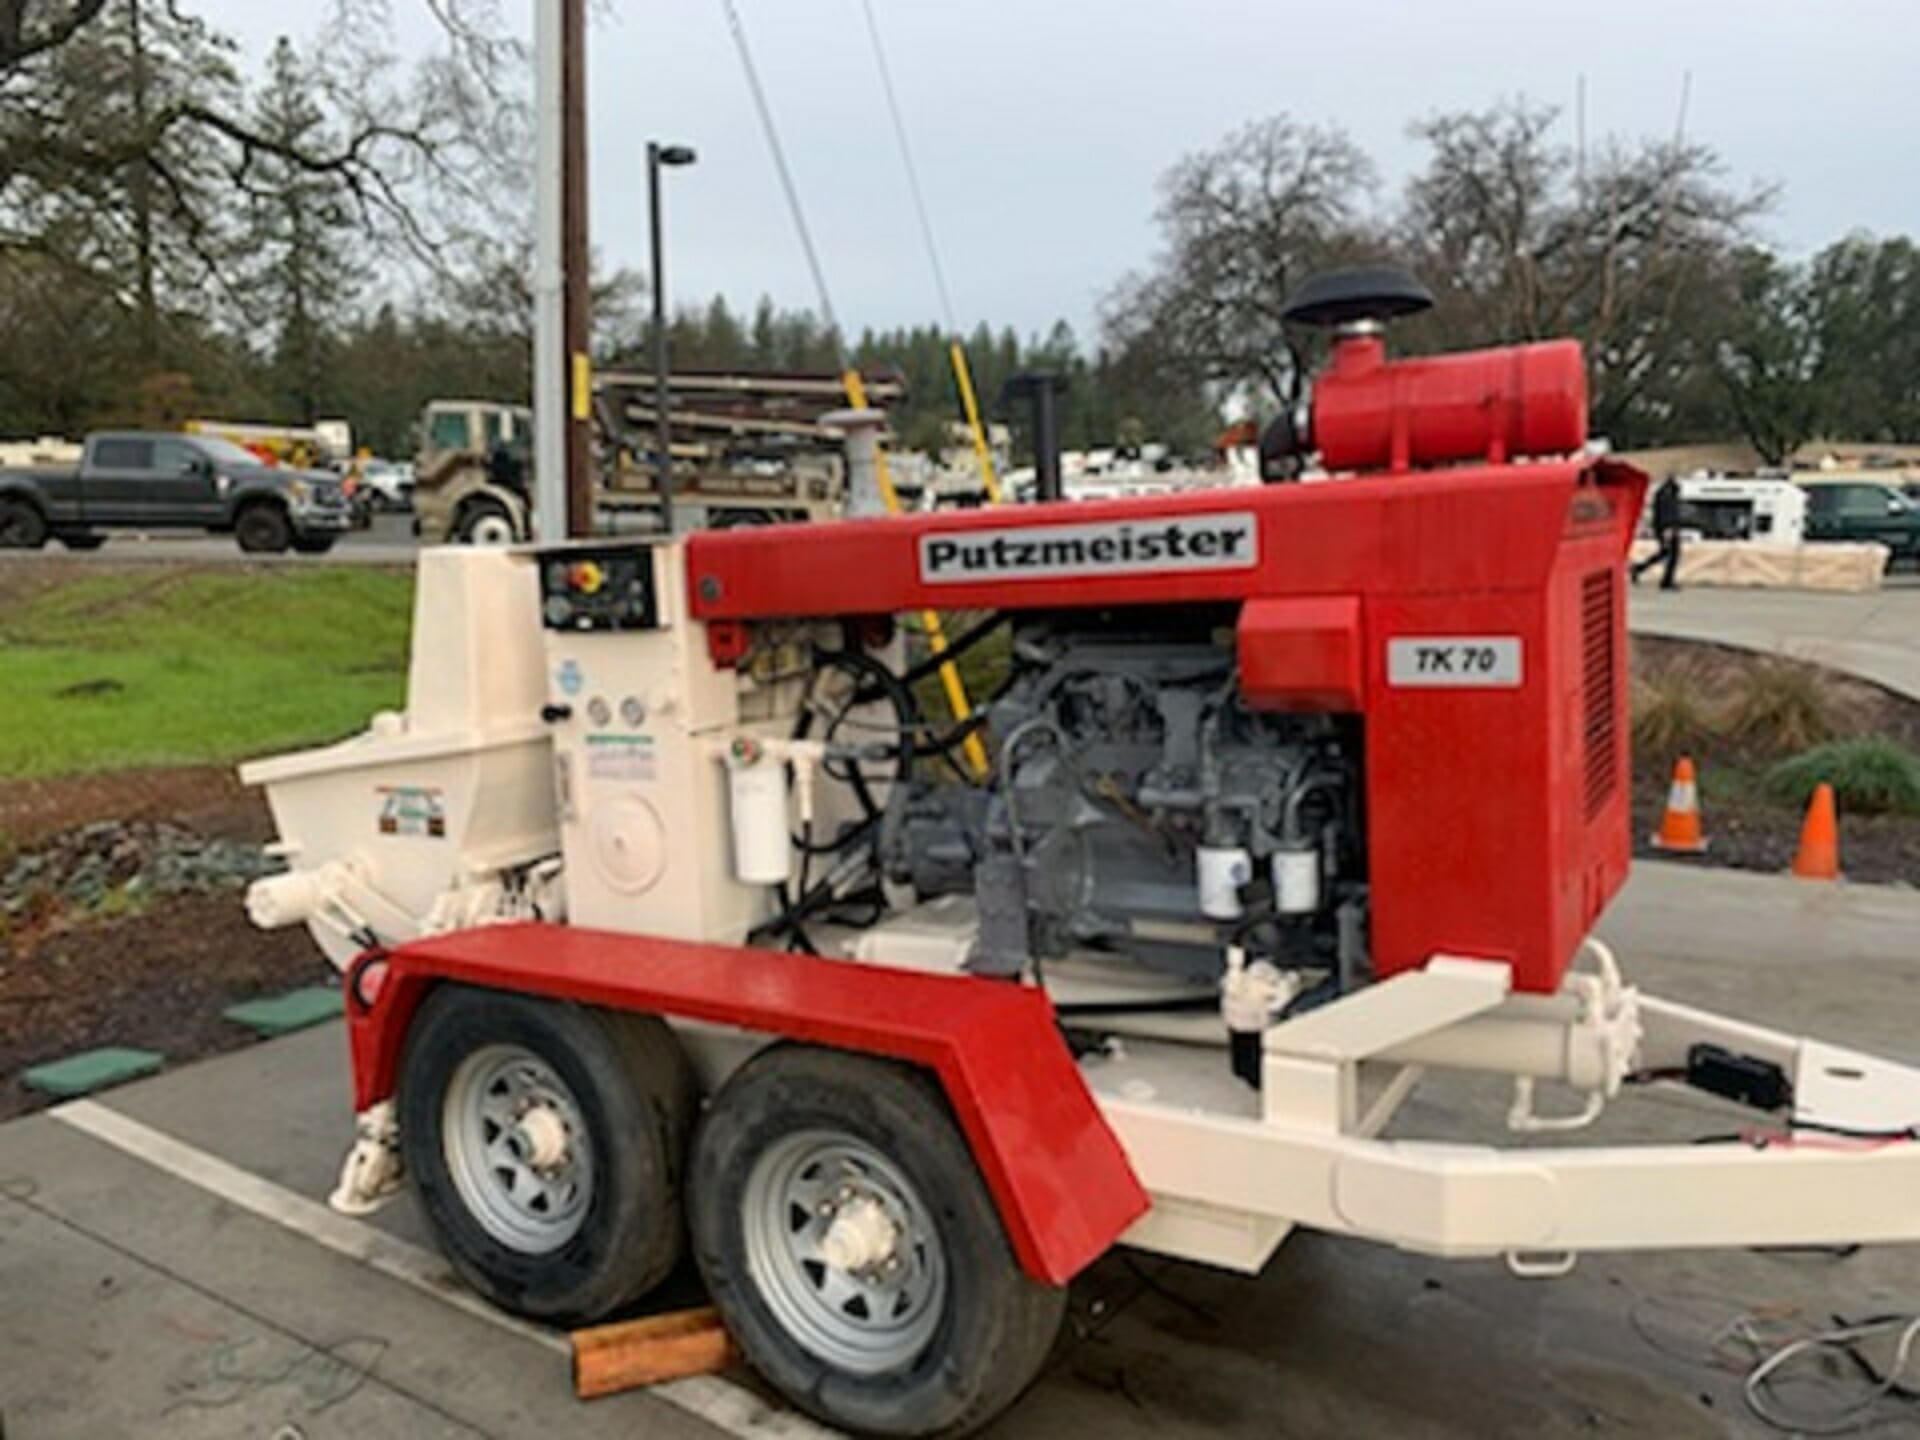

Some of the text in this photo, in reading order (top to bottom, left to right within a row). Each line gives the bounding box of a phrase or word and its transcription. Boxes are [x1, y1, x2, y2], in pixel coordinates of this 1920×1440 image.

[927, 524, 1246, 572] Putzmeister
[1415, 647, 1497, 672] TK 70
